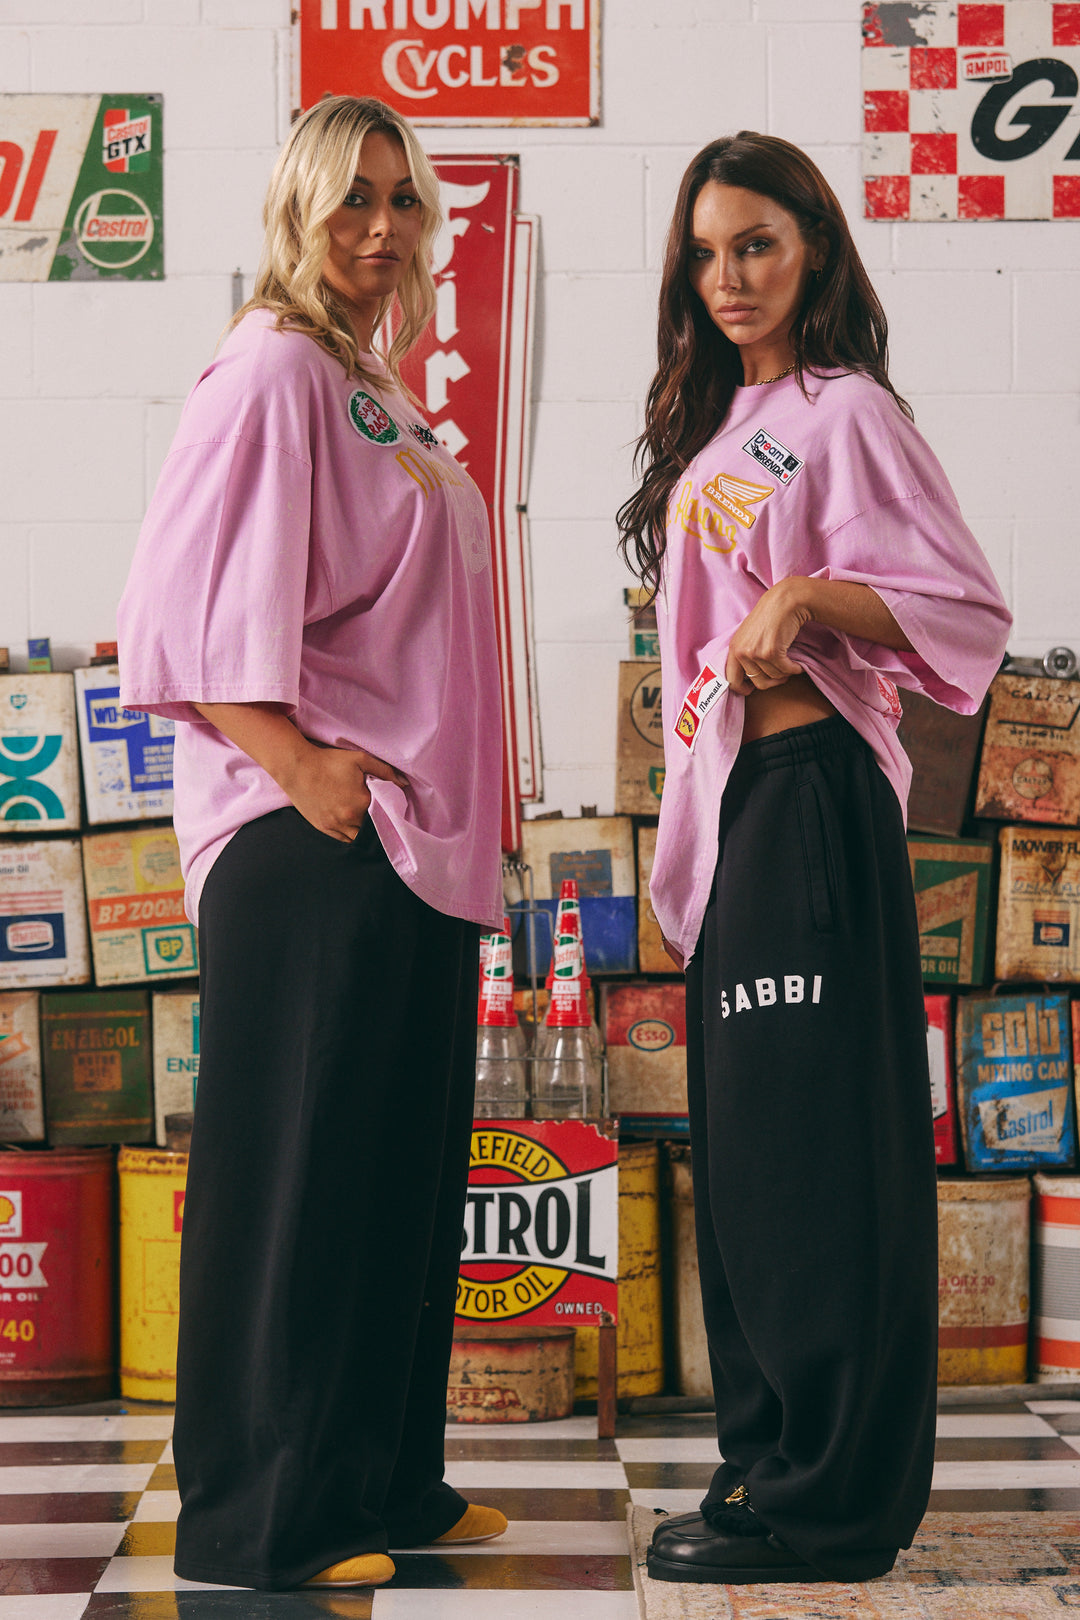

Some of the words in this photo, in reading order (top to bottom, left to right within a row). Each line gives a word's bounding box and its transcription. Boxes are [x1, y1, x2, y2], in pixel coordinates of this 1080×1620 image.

[381, 40, 560, 98] CYCLES
[966, 60, 1009, 76] AMPOL
[107, 120, 148, 142] Castrol
[107, 133, 146, 160] GTX
[86, 218, 149, 237] Castrol
[754, 433, 785, 462] Dream
[758, 452, 785, 478] BRENDA
[706, 485, 752, 525] BRENDA
[698, 680, 723, 713] Mermaid
[94, 706, 143, 724] WD-40
[1012, 838, 1064, 854] MOWER
[96, 903, 127, 925] BP
[127, 896, 185, 921] ZOOM
[158, 940, 183, 957] BP
[938, 960, 958, 975] OIL
[720, 974, 823, 1020] SABBI
[51, 1026, 140, 1050] ENERGOL
[977, 1063, 1034, 1083] MIXING
[1037, 1060, 1068, 1080] CAN
[996, 1099, 1054, 1141] Castrol
[461, 1178, 606, 1270] TROL
[513, 1270, 554, 1305] OIL
[554, 1302, 604, 1315] OWNED
